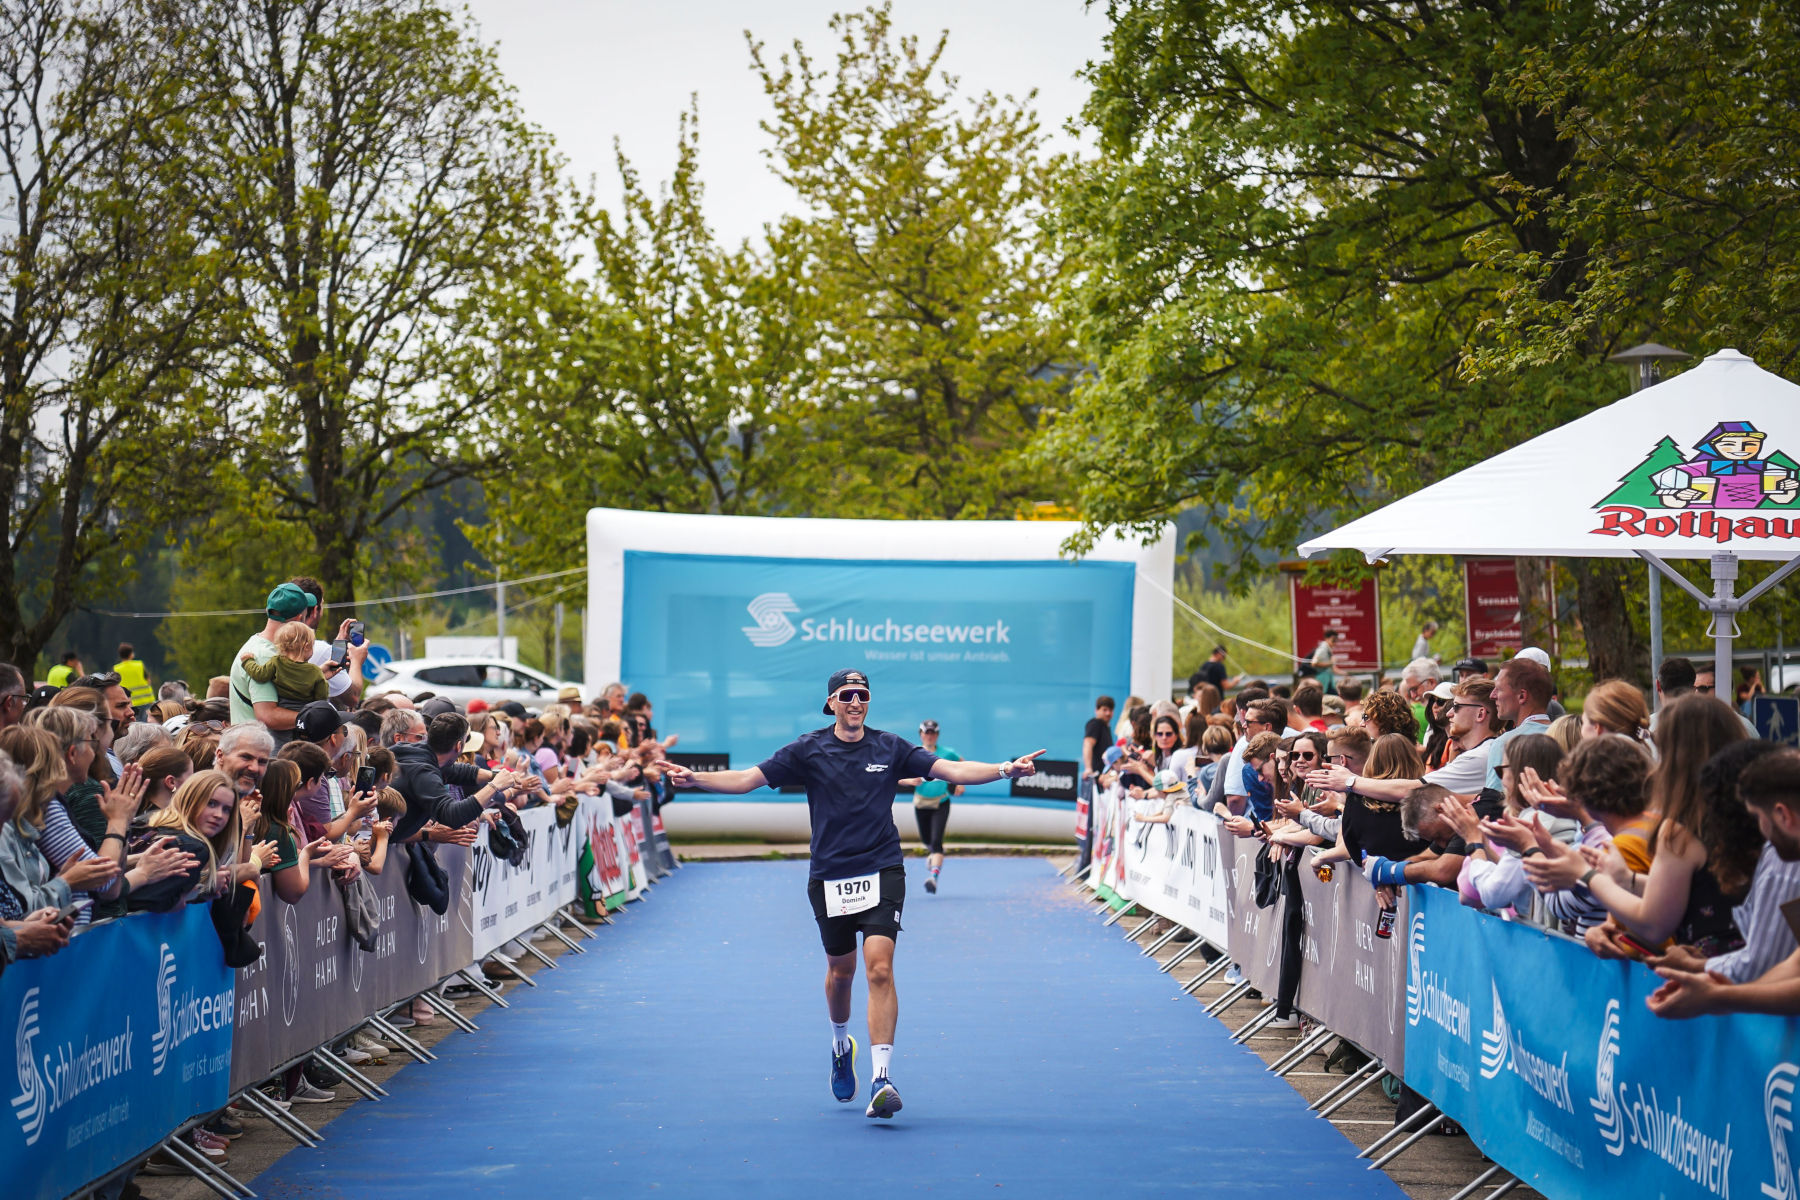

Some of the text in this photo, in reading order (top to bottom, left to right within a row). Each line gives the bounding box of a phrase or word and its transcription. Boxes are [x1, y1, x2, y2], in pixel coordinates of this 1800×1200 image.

[801, 617, 1010, 644] Schluchseewerk
[864, 649, 907, 662] Wasser
[909, 649, 924, 662] ist
[927, 652, 961, 662] unser
[836, 880, 871, 896] 1970
[842, 896, 866, 904] Dominik
[315, 955, 338, 990] HAHN
[1620, 1081, 1733, 1200] Schluchseewerk
